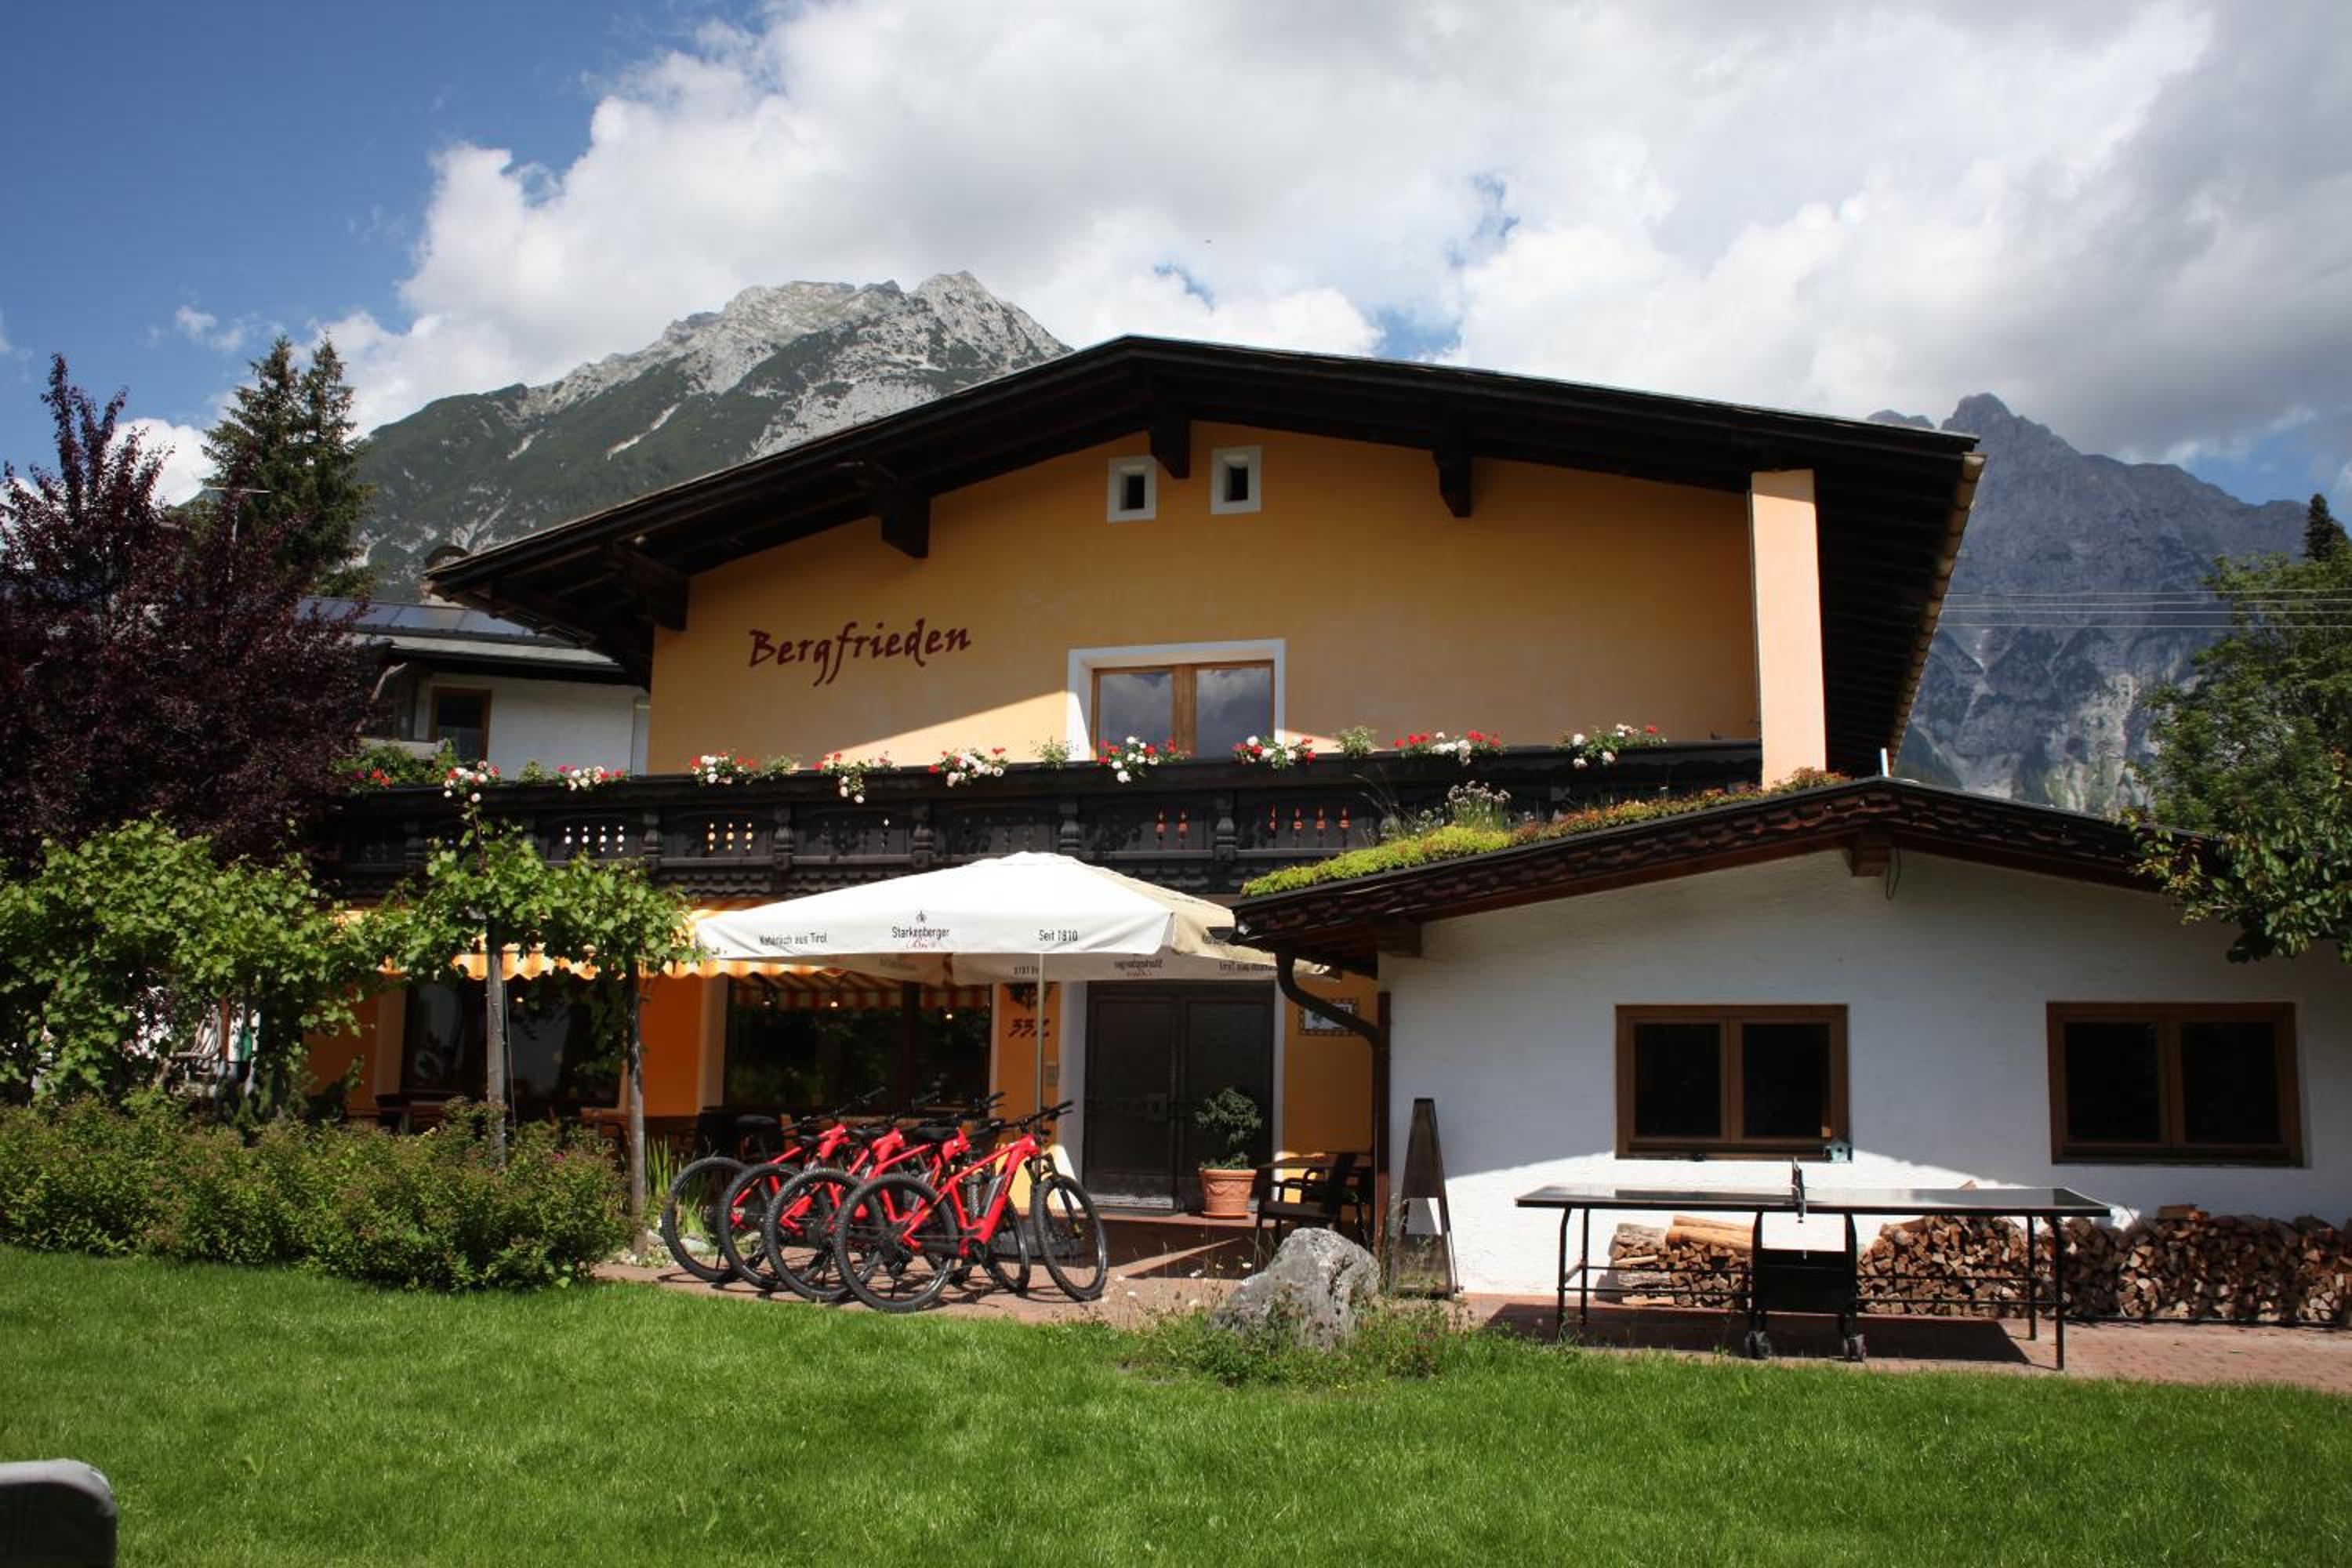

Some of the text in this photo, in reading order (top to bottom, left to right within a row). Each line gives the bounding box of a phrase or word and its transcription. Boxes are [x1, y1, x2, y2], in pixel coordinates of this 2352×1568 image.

[749, 618, 971, 687] Bergfrieden
[810, 931, 827, 943] Tirol
[1039, 929, 1078, 942] Seit 1810
